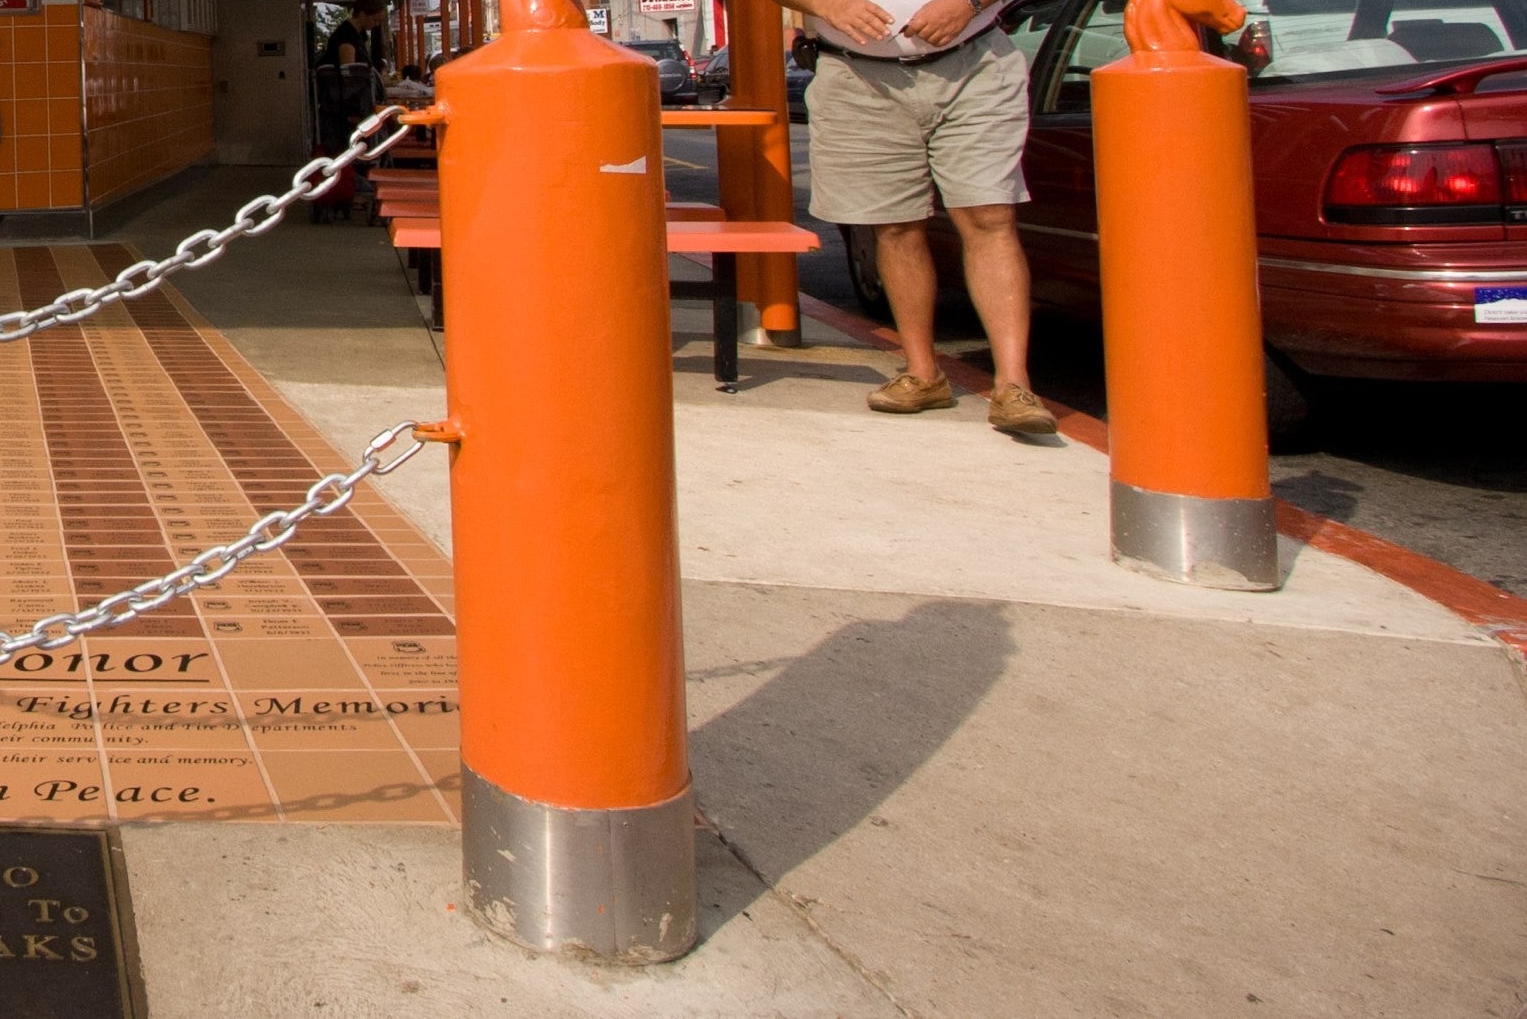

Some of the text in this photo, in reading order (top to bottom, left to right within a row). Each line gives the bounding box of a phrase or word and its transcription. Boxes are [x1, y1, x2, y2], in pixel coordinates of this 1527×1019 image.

[17, 694, 228, 720] Fighters
[254, 695, 459, 715] Memori
[71, 721, 133, 731] Police
[142, 722, 176, 731] and
[179, 723, 218, 732] Fire
[223, 723, 358, 733] Departments
[32, 735, 149, 745] community.
[2, 754, 47, 764] their
[57, 755, 132, 764] service
[137, 755, 170, 764] and
[177, 756, 253, 767] memory.
[34, 779, 215, 803] Peace.
[28, 899, 90, 924] To
